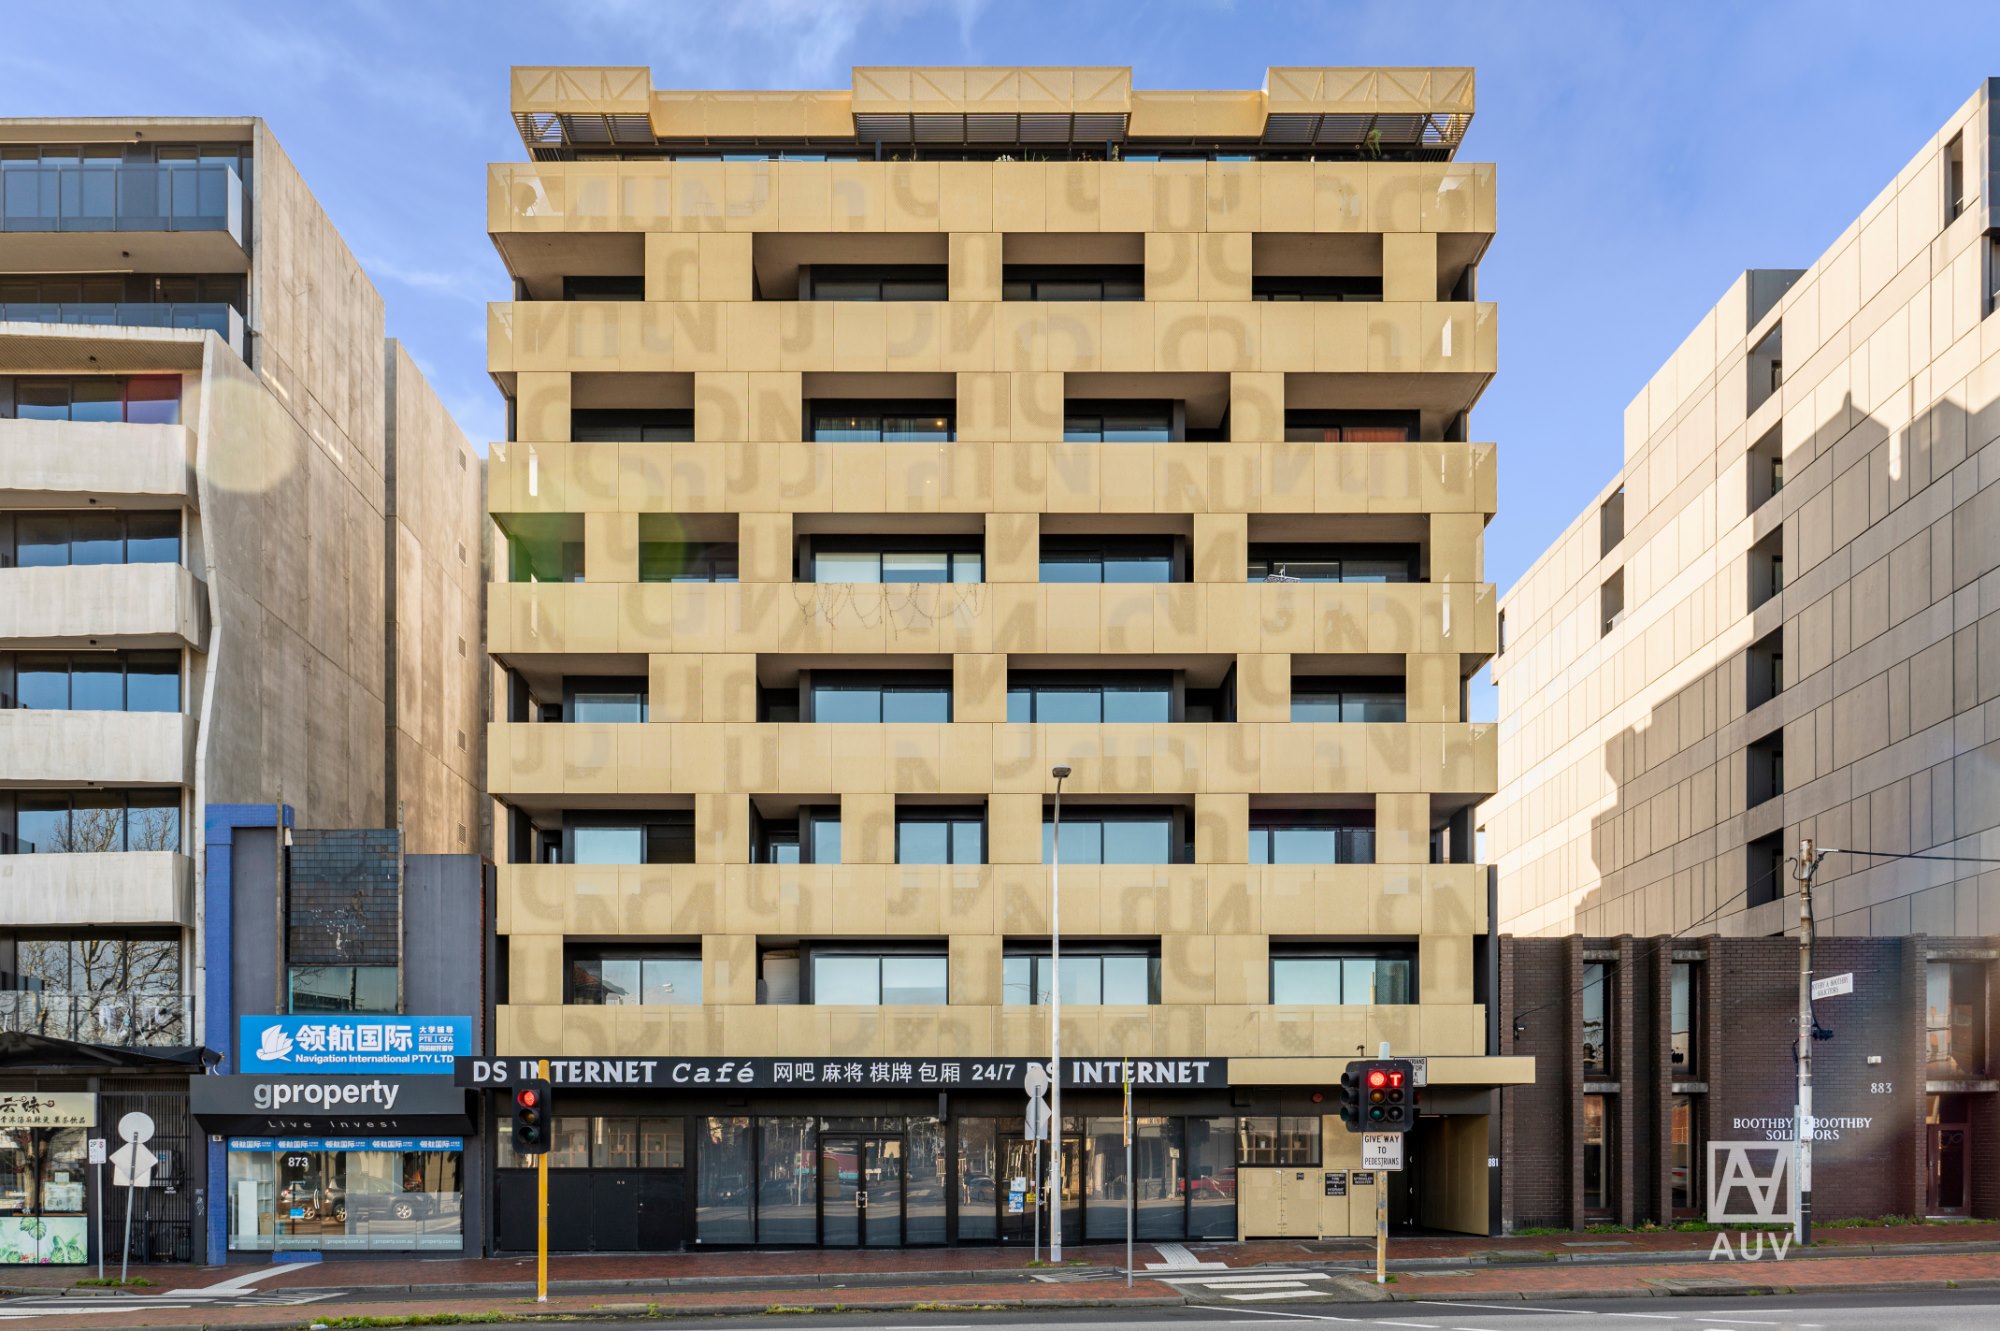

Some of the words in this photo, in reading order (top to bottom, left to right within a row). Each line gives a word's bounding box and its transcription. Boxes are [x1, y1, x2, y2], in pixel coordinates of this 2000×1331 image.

[295, 1024, 413, 1052] 领航国际
[295, 1053, 347, 1065] Navigation
[348, 1053, 410, 1064] International
[411, 1054, 432, 1063] PTY
[434, 1054, 455, 1063] LTD
[473, 1061, 508, 1083] DS
[671, 1061, 755, 1083] Café
[773, 1061, 816, 1083] 网吧
[822, 1061, 864, 1083] 麻将
[869, 1061, 913, 1083] 棋牌
[918, 1061, 961, 1083] 包厢
[971, 1063, 1016, 1081] 24/7
[1072, 1061, 1210, 1083] INTERNET
[1870, 1082, 1893, 1094] 883
[253, 1079, 400, 1110] gproperty
[267, 1120, 312, 1128] Live
[330, 1120, 398, 1128] Invest
[1733, 1117, 1794, 1129] BOOTHBY
[1813, 1117, 1873, 1129] BOOTHBY
[1364, 1135, 1381, 1143] GIVE
[1383, 1135, 1400, 1143] WAY
[1765, 1129, 1840, 1141] SOLIORS
[1378, 1146, 1387, 1154] TO
[288, 1157, 309, 1167] 873
[1364, 1157, 1400, 1167] PEDESTRIANS
